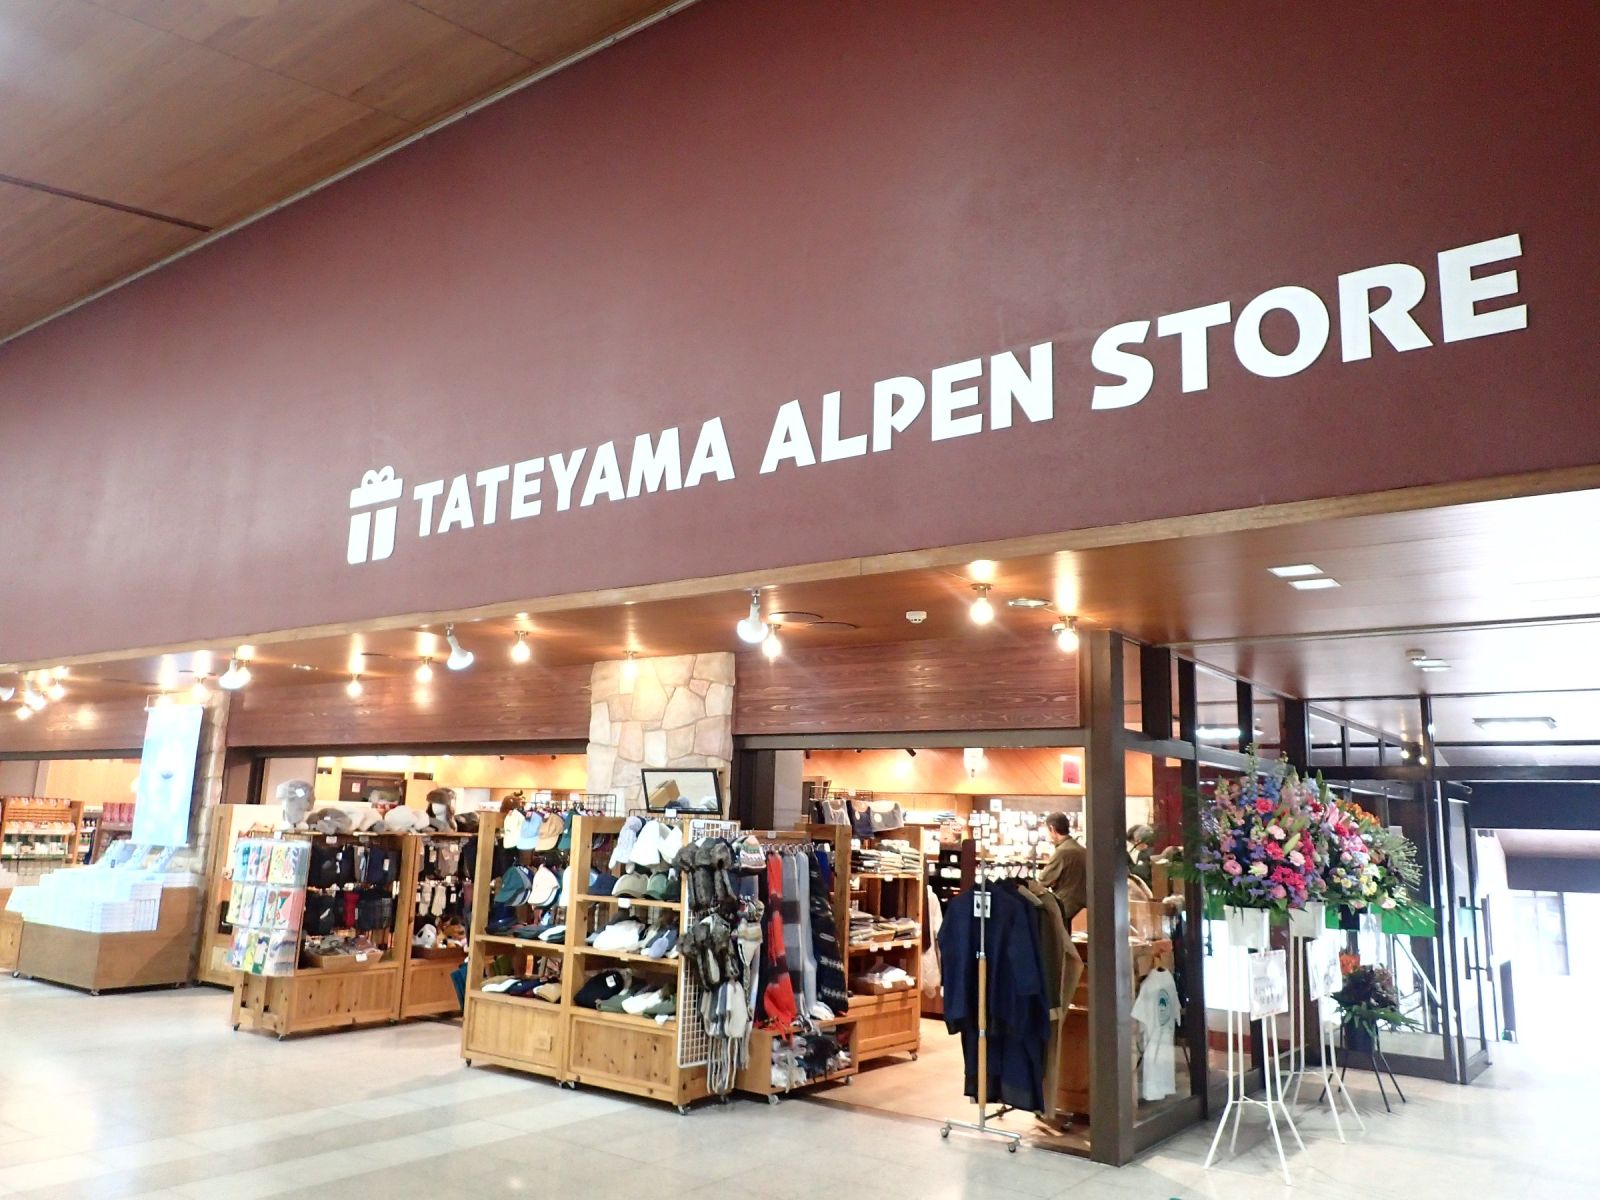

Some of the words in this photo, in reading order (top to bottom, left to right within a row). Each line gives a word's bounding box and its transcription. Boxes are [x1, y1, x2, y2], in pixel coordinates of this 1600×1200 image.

[411, 416, 736, 538] TATEYAMA
[759, 341, 1054, 475] ALPEN
[1091, 233, 1528, 410] STORE
